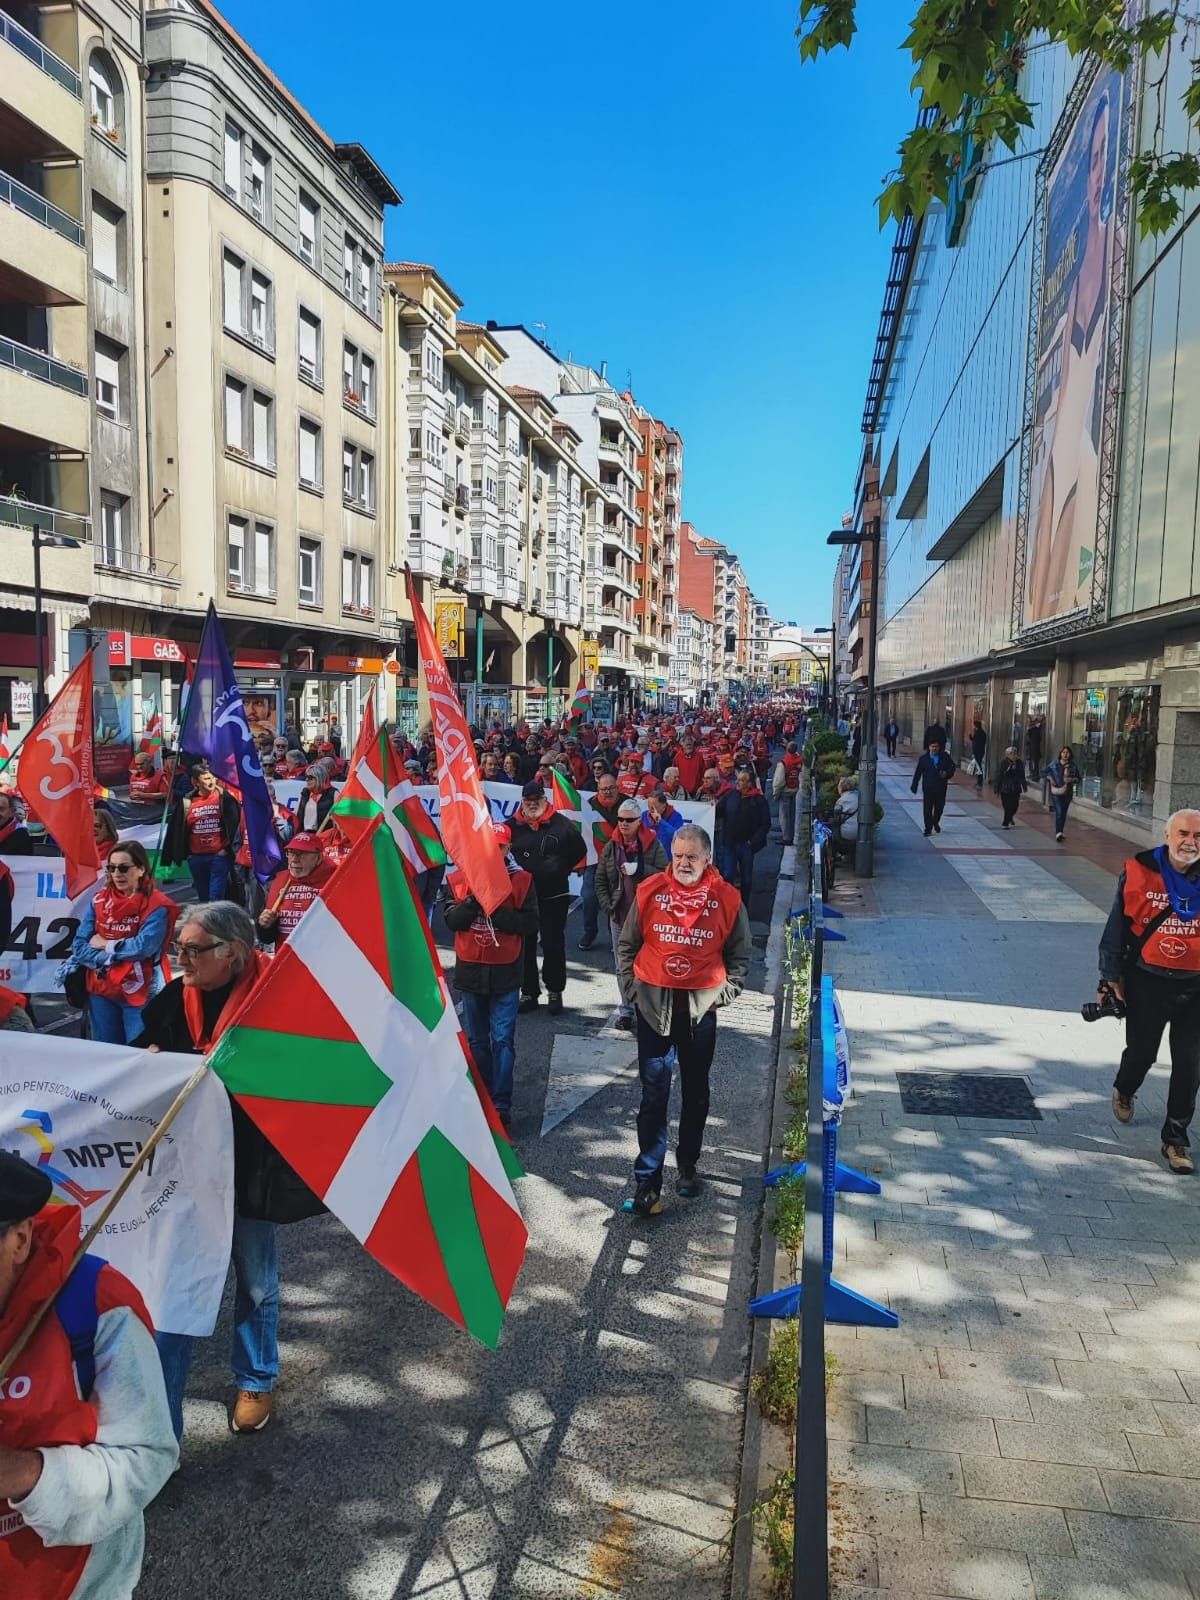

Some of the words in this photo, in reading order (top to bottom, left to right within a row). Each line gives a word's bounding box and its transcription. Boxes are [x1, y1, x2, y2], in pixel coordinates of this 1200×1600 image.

[153, 642, 180, 658] GAES
[1157, 926, 1197, 935] OLDATA
[659, 933, 703, 947] SOLDATA
[104, 1223, 120, 1234] DE
[144, 1179, 179, 1220] HERRIA
